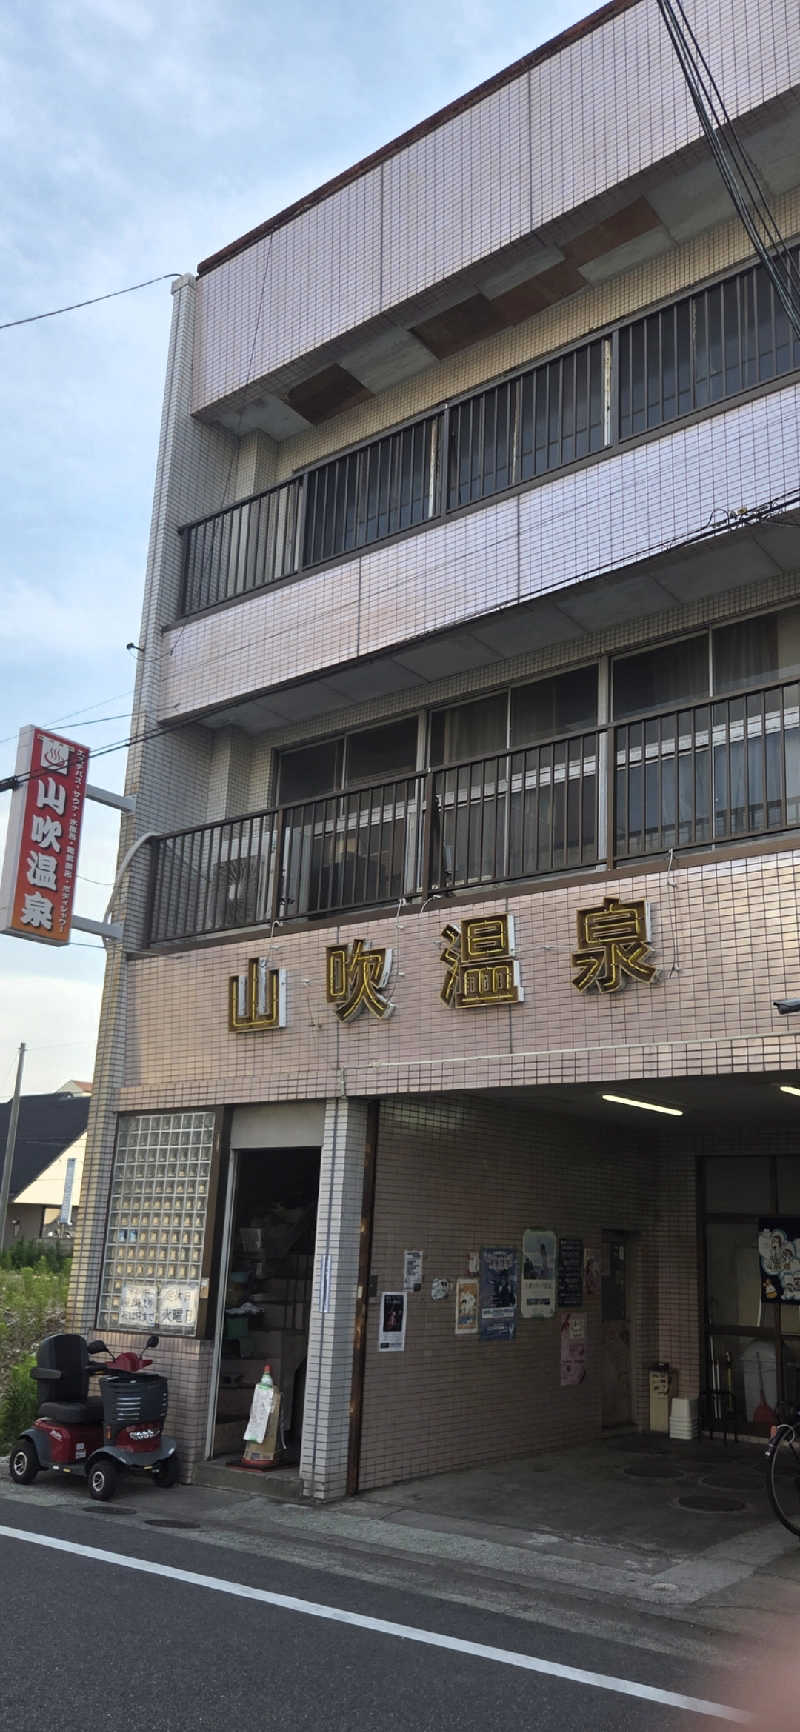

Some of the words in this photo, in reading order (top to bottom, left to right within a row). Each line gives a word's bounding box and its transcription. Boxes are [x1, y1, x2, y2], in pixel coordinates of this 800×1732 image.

[21, 777, 66, 931] 山吹温泉
[228, 896, 660, 1032] 山吹温泉
